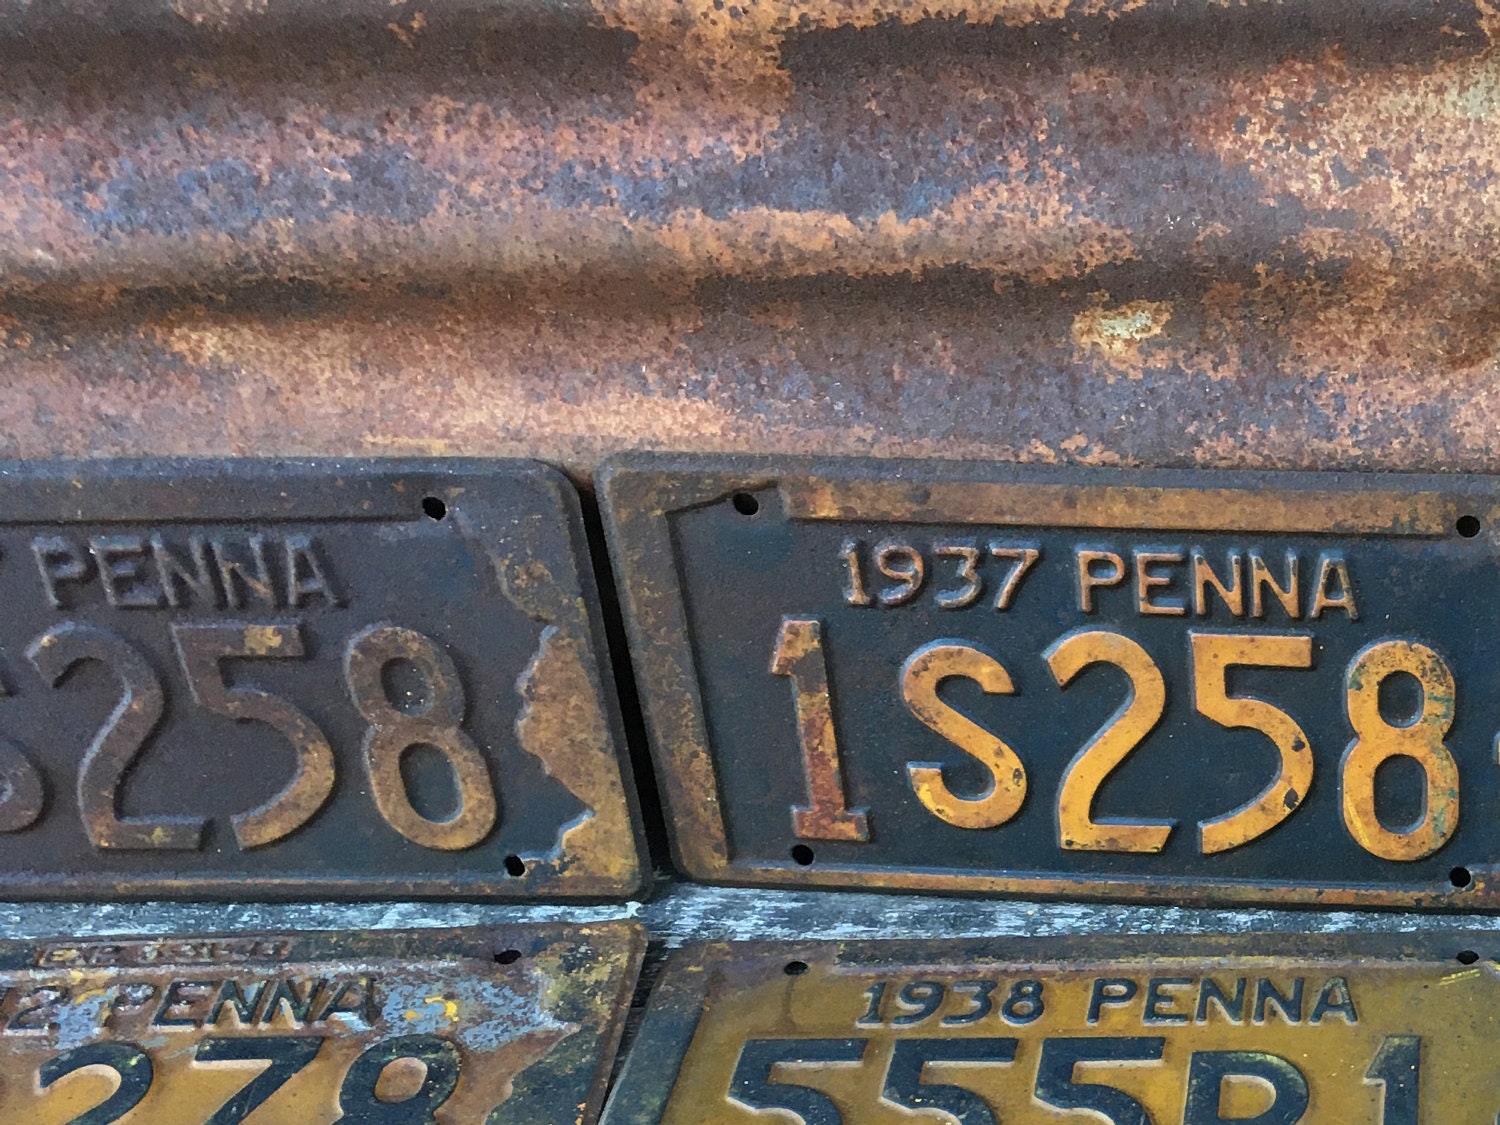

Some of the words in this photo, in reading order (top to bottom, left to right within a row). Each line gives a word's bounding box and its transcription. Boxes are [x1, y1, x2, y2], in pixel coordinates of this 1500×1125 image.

[31, 534, 342, 608] PENNA
[840, 536, 1040, 611] 1937
[1074, 543, 1358, 621] PENNA
[769, 614, 1460, 862] 1S258
[856, 978, 1044, 1027] 1938
[1086, 975, 1358, 1025] PENNA
